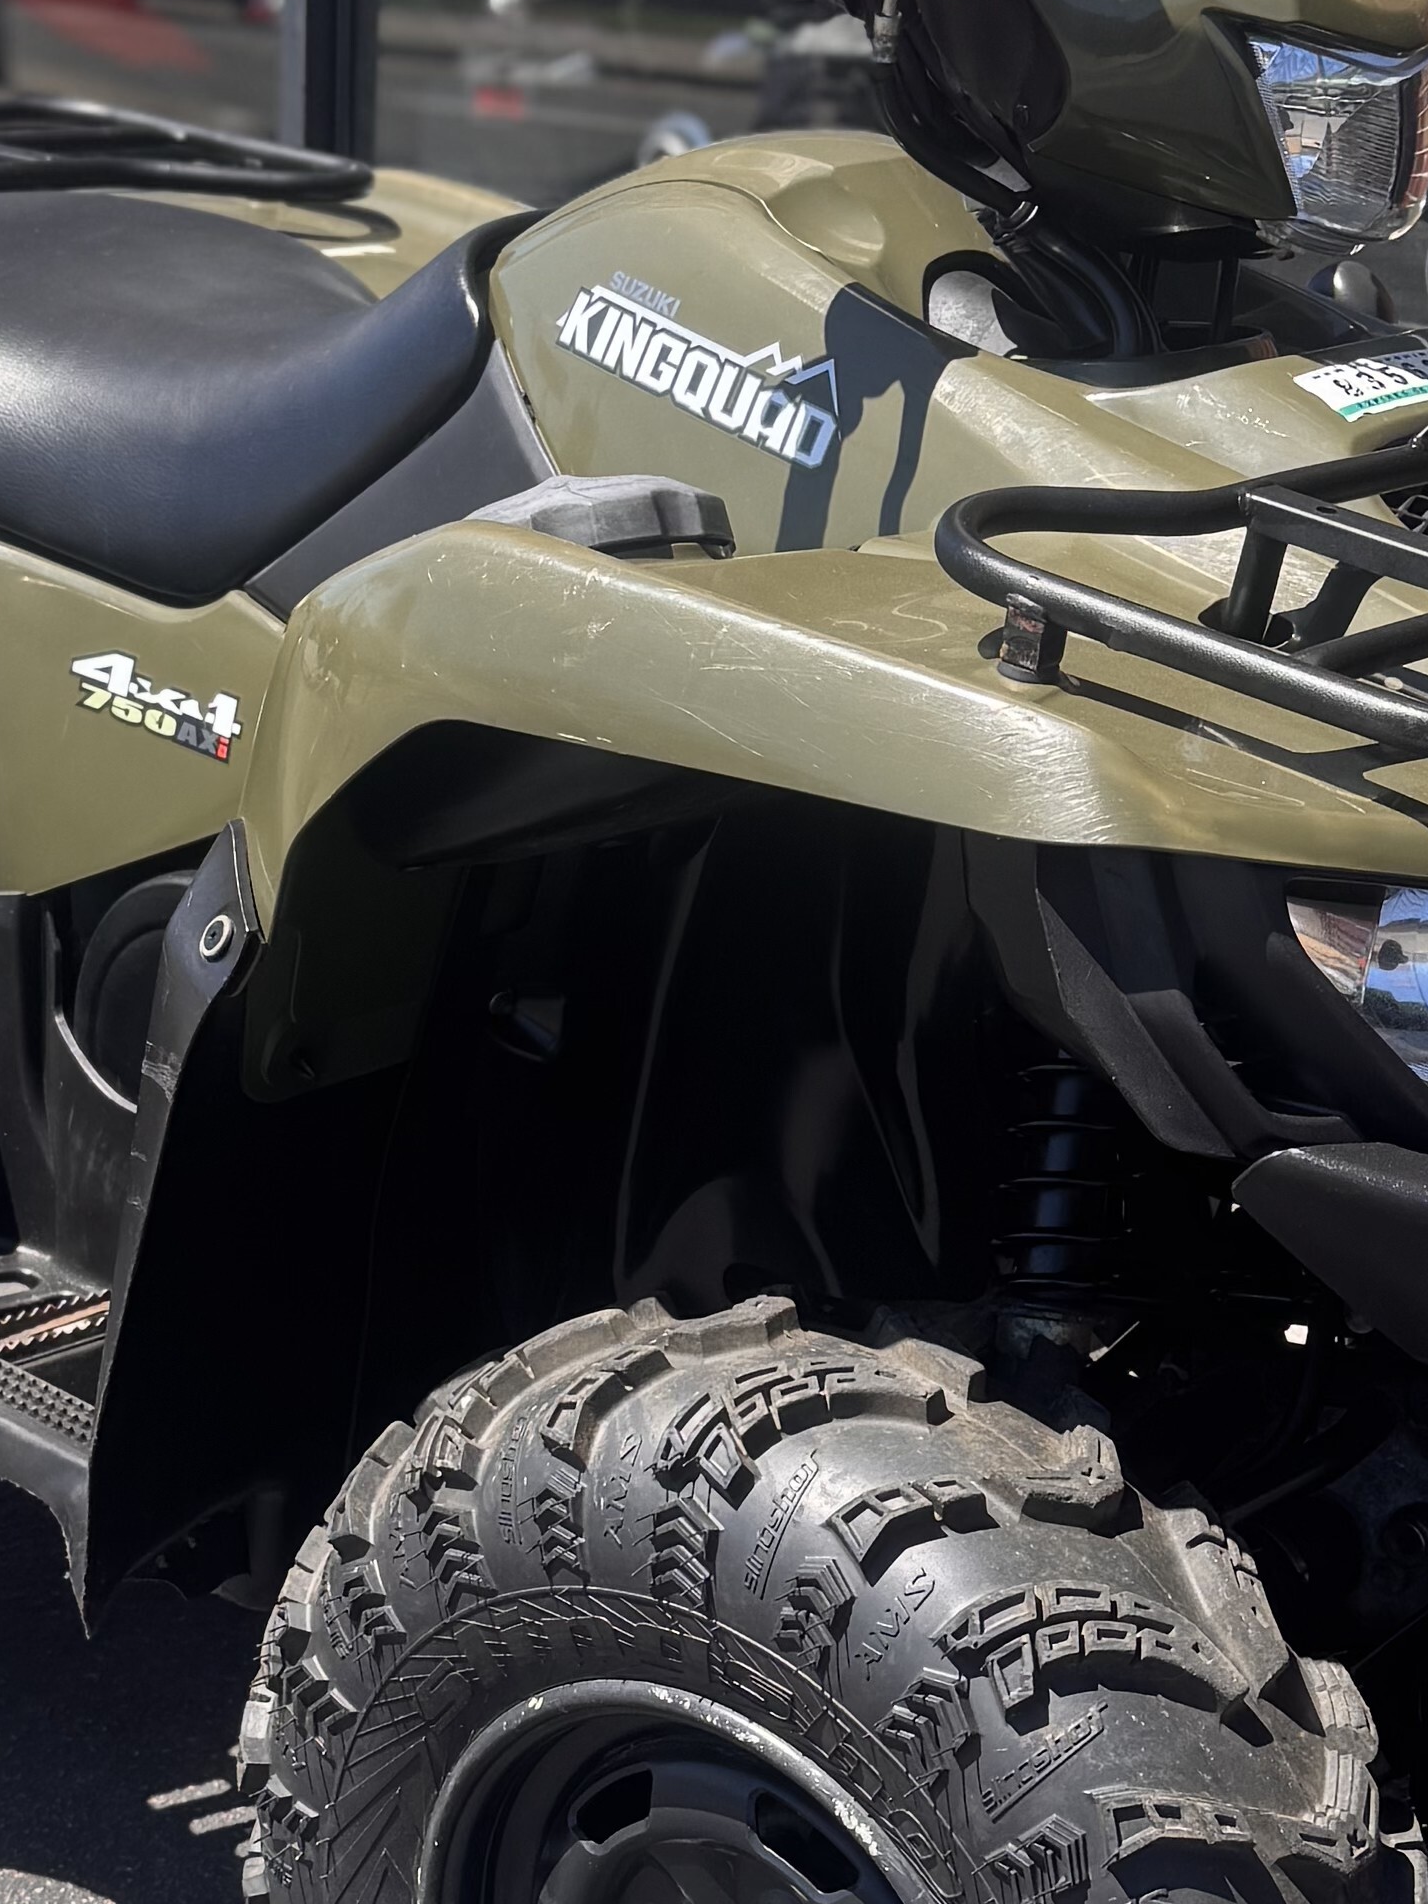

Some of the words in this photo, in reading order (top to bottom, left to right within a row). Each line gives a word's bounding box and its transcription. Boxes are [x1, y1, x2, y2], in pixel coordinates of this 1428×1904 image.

[609, 270, 682, 318] SUZUKI
[556, 286, 840, 469] KINGQUAD
[71, 652, 242, 739] 4x4
